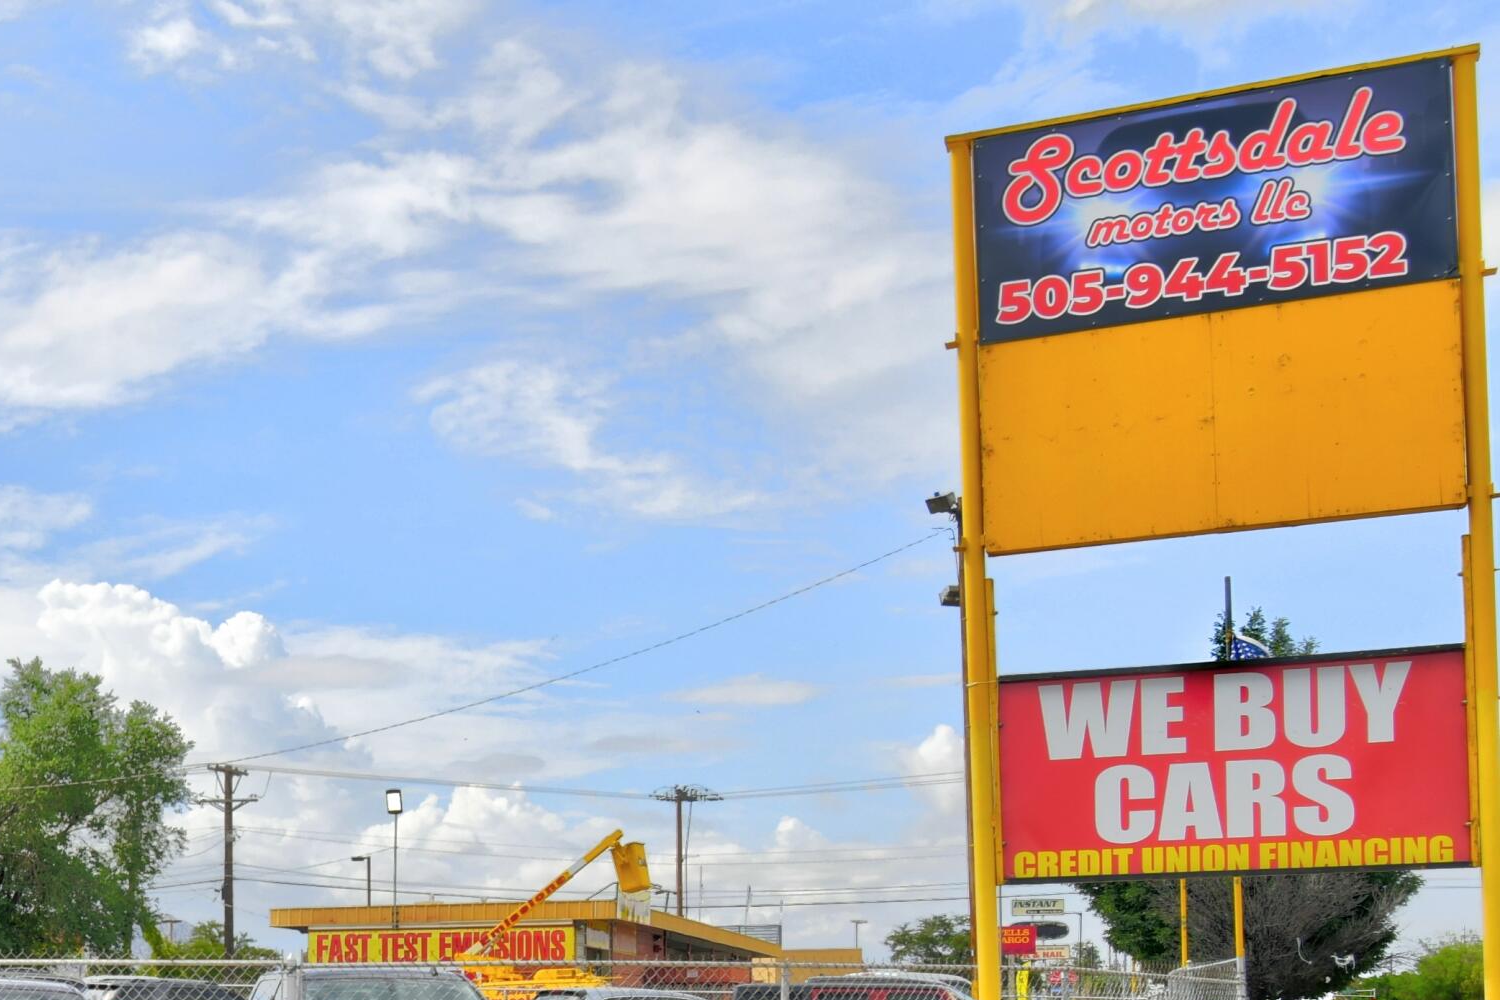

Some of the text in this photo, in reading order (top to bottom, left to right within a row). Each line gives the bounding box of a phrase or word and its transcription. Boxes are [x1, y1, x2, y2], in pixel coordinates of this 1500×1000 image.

[1002, 86, 1407, 225] Scottsdale
[1087, 178, 1311, 247] motors llc
[996, 232, 1407, 324] 505-944-5152
[1038, 661, 1412, 760] WE BUY
[1094, 754, 1355, 845] CARS
[1014, 835, 1454, 879] CREDIT UNION FINANCING
[1002, 928, 1030, 936] ELLS
[1013, 900, 1058, 908] INSTANT
[315, 932, 372, 963] FAST
[379, 931, 432, 963] TEST
